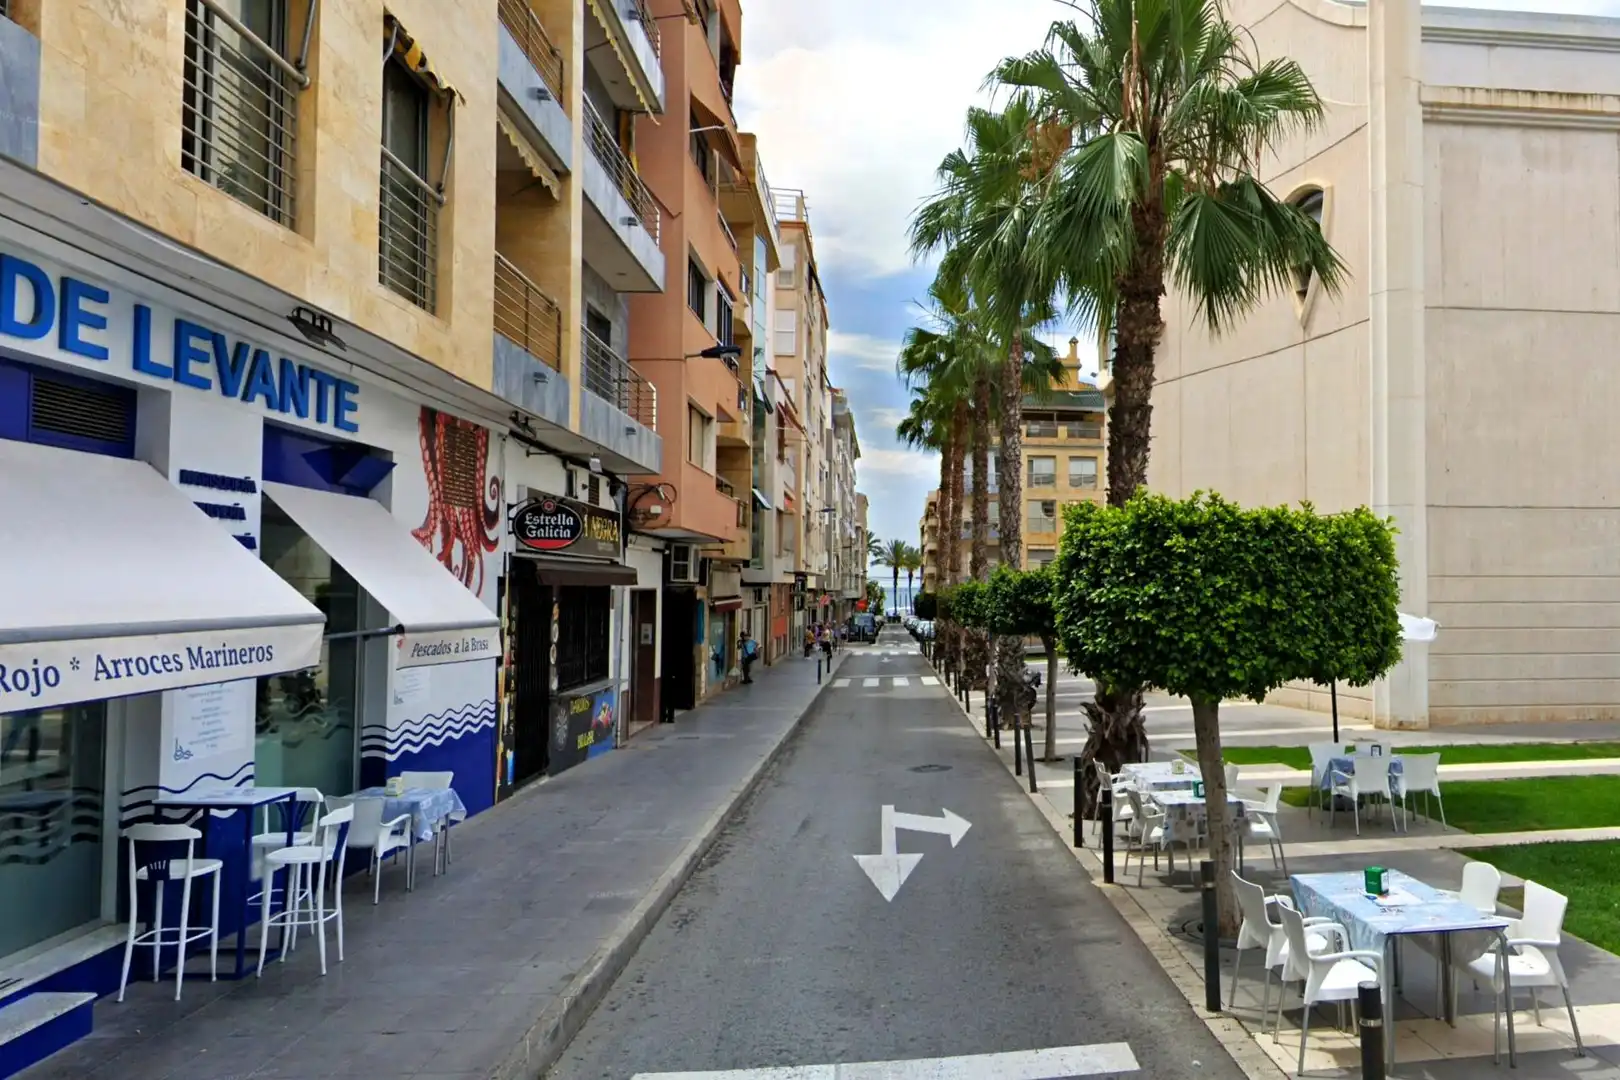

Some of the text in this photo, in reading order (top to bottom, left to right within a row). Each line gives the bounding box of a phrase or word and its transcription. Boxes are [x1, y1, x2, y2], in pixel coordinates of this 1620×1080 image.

[0, 254, 359, 433] DE LEVANTE
[524, 513, 574, 526] Estrella
[526, 525, 571, 538] Galicia
[410, 640, 452, 657] Pescados
[454, 643, 460, 653] a
[461, 638, 469, 652] la
[0, 643, 273, 697] Rojo Arroces Marineros
